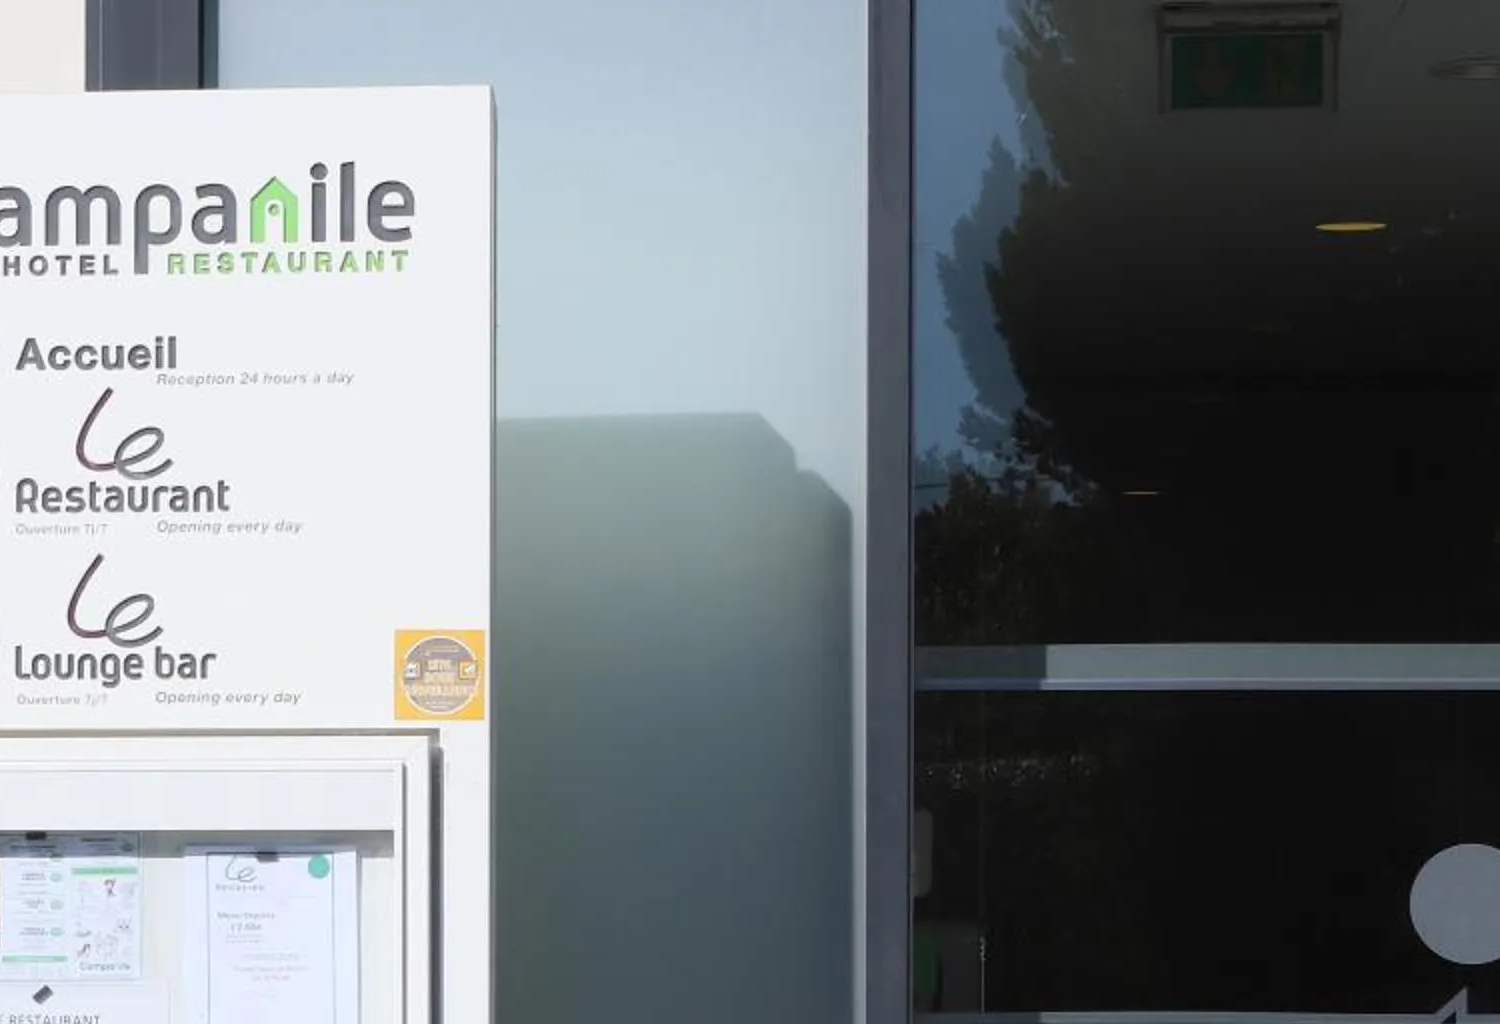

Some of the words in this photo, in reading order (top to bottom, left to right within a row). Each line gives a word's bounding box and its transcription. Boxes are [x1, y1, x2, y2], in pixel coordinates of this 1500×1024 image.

[2, 254, 120, 277] HOTEL
[167, 249, 410, 275] RESTAURANT
[15, 335, 178, 371] Accueil
[156, 372, 236, 388] Reception
[239, 372, 260, 386] 24
[262, 371, 308, 386] hours
[326, 369, 354, 387] day
[75, 386, 174, 481] Le
[15, 476, 231, 514] Restaurant
[156, 519, 221, 535] Opening
[227, 521, 271, 535] every
[274, 519, 303, 535] day
[67, 552, 164, 648] Le
[14, 644, 144, 688] Lounge
[155, 645, 218, 681] bar
[155, 691, 221, 706] Opening
[225, 692, 269, 706] every
[272, 690, 301, 706] day
